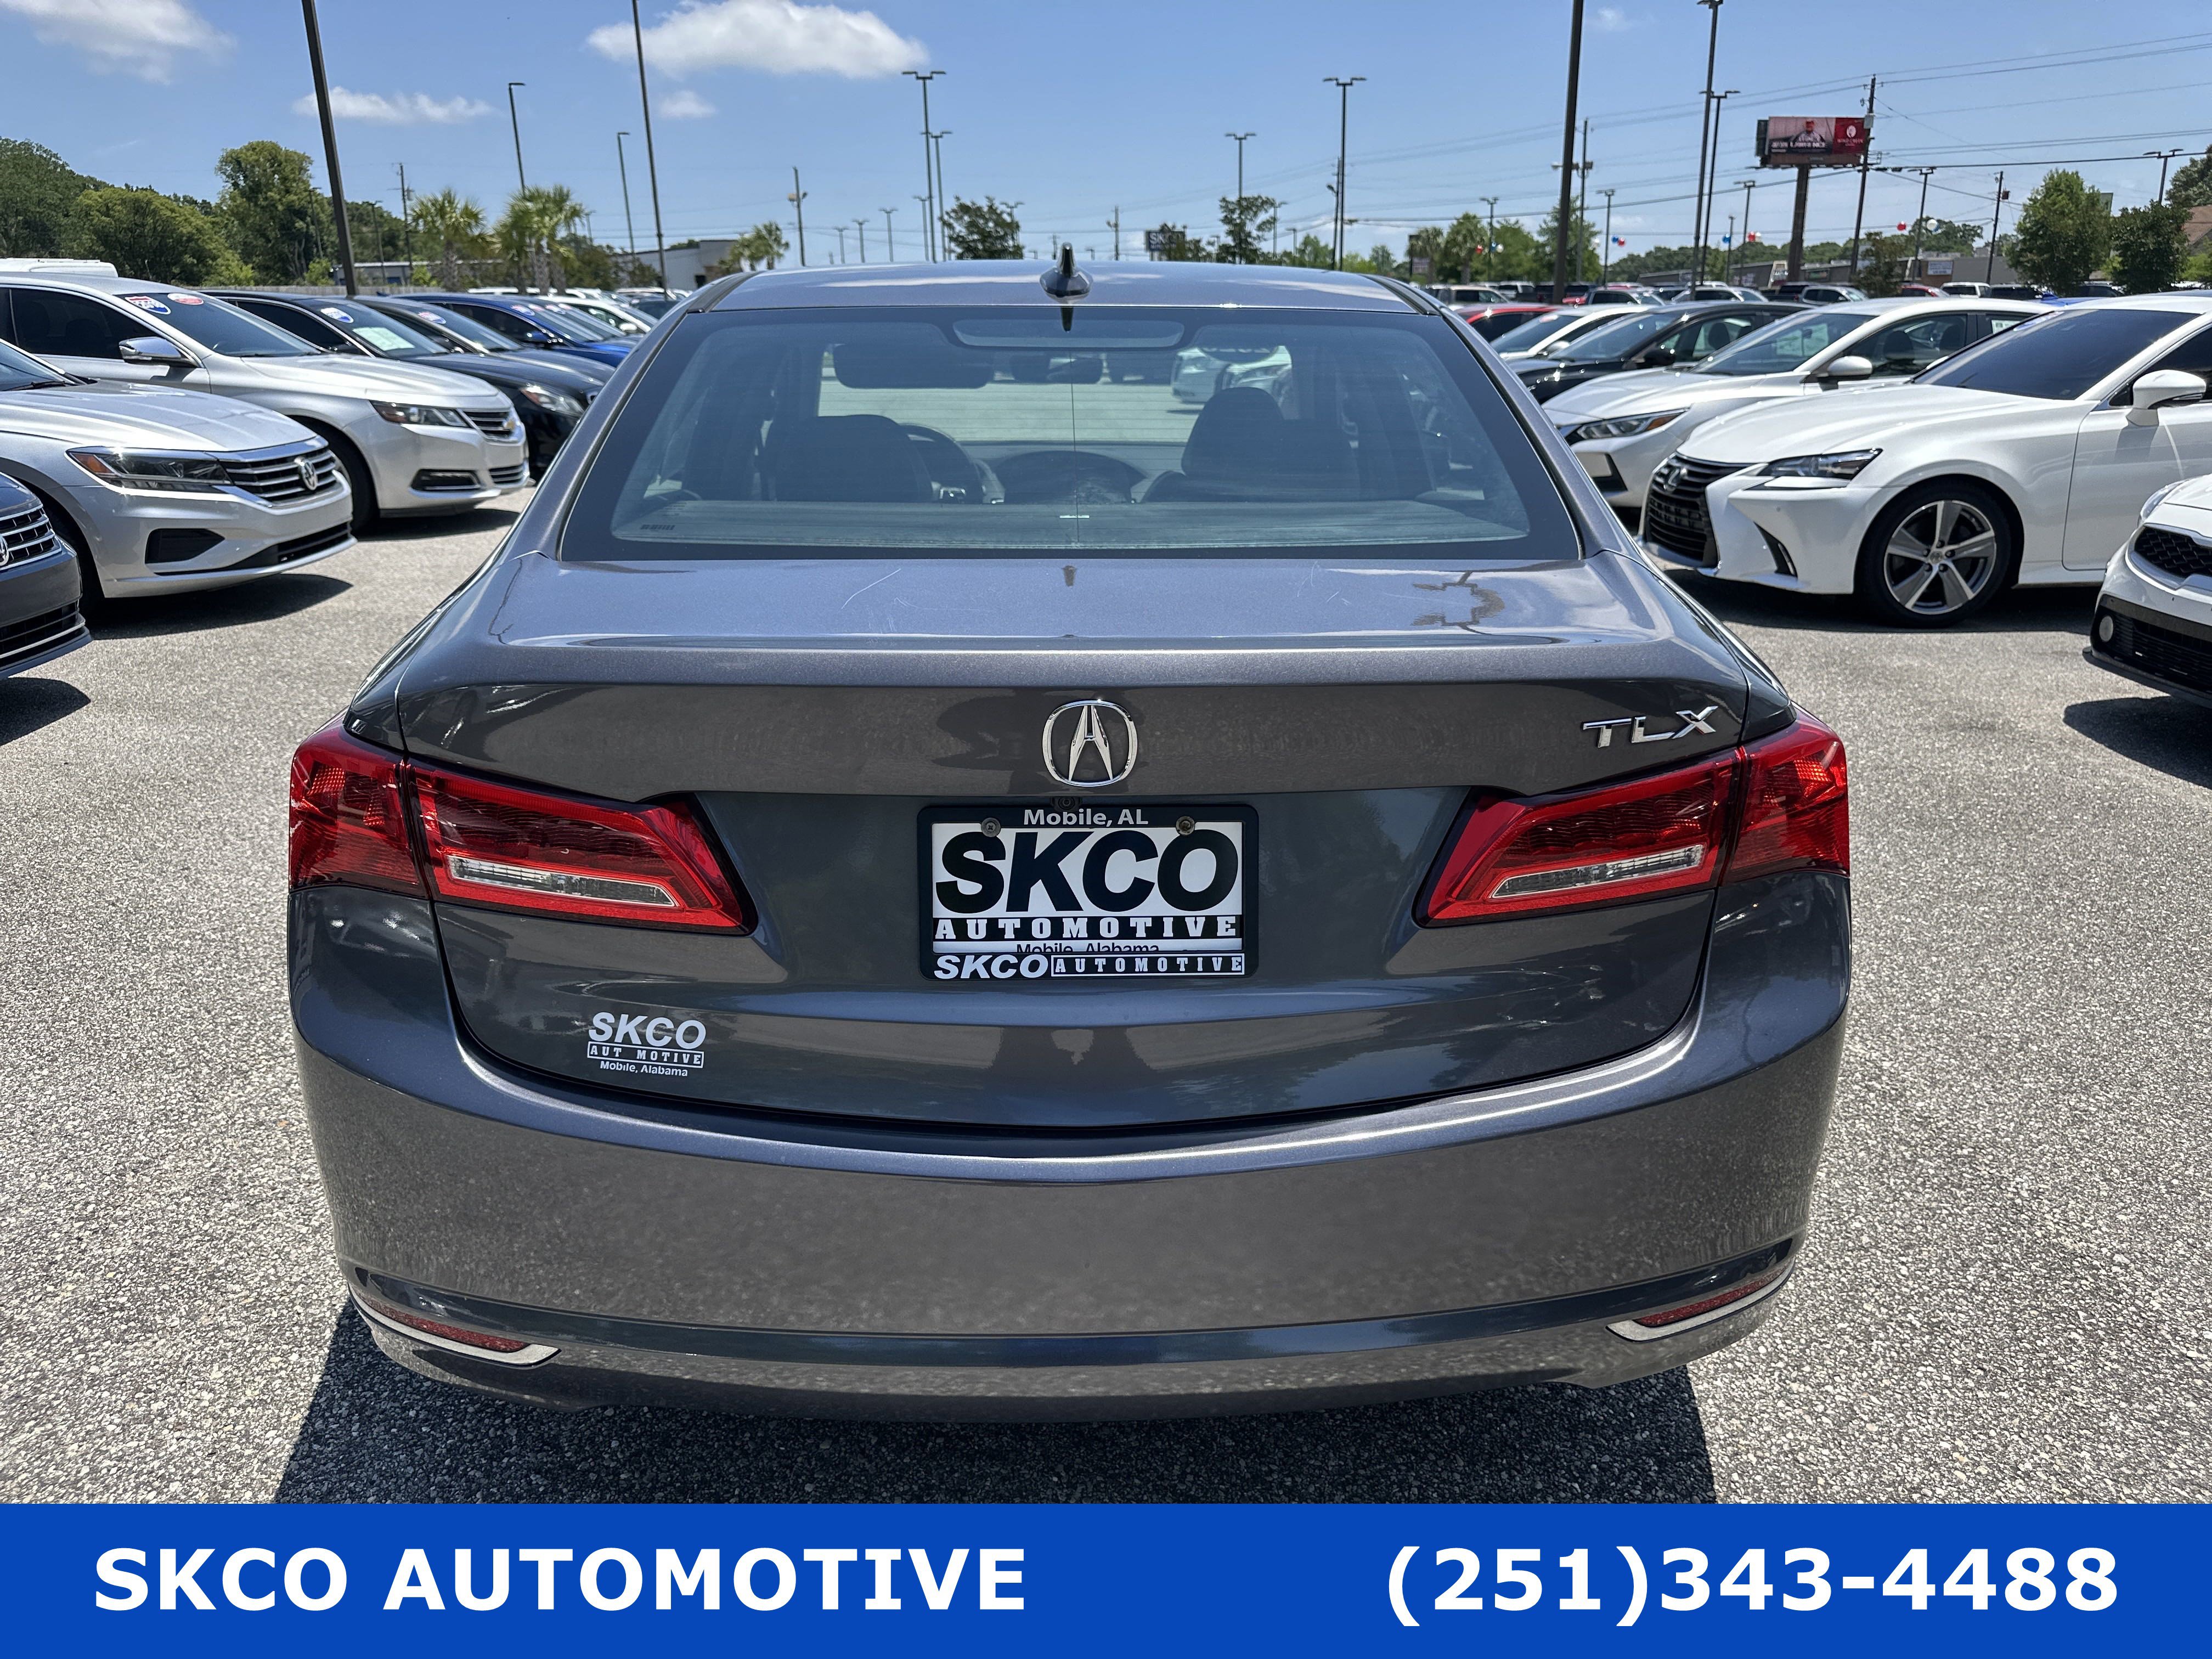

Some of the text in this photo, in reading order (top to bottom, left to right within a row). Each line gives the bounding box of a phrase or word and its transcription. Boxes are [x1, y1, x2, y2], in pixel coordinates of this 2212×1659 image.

[1583, 706, 1719, 748] TLX
[1024, 809, 1149, 827] Mobile, AL
[935, 829, 1239, 914] SKCO
[935, 917, 1237, 940] AUTOMOTIVE
[934, 955, 1242, 979] SKCO AUTOMOTIVE
[589, 1012, 707, 1049] SKCO
[600, 1060, 688, 1076] Mobile, Alabama
